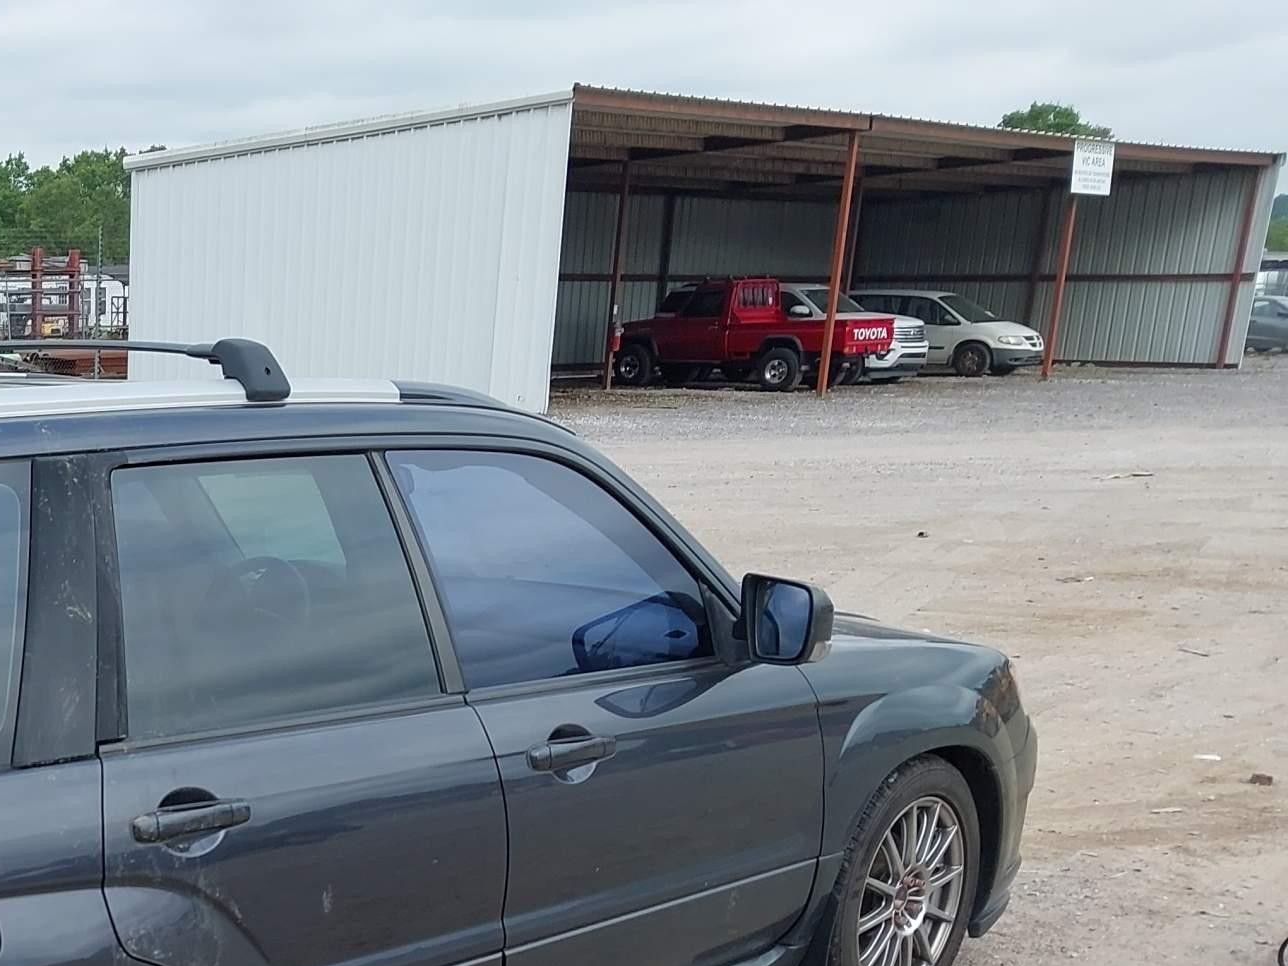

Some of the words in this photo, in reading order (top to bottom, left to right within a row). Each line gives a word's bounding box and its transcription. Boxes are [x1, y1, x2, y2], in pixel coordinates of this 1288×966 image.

[1076, 142, 1113, 155] PROGRESSIVE
[1091, 157, 1105, 168] AREA
[853, 327, 887, 340] TOYOTA
